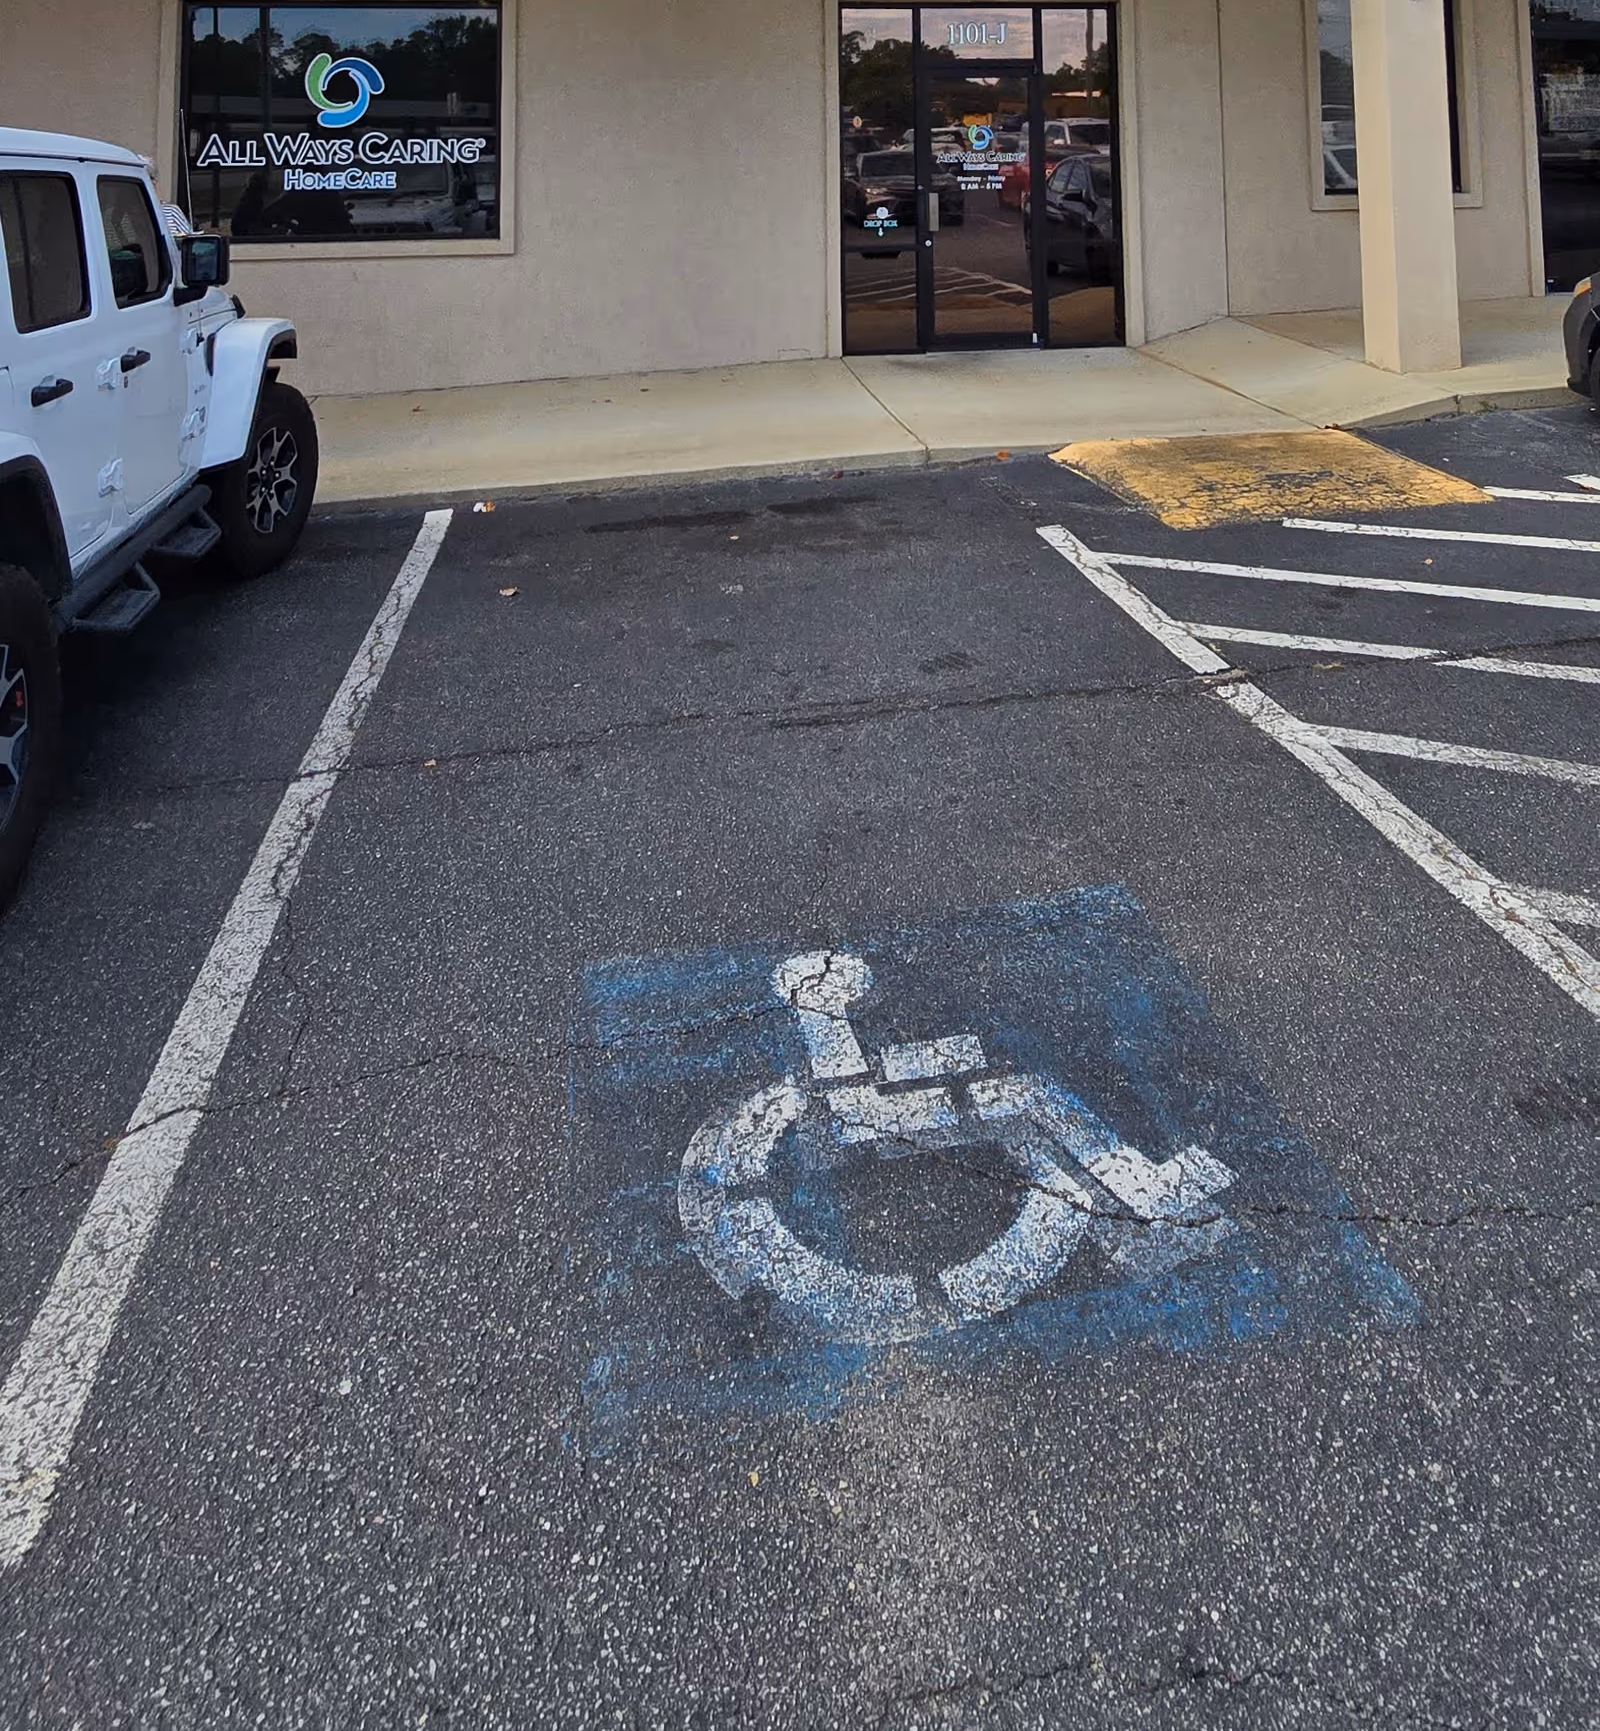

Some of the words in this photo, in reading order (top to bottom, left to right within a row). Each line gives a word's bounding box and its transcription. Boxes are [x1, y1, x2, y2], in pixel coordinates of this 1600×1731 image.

[948, 22, 1007, 45] 1101-J
[197, 134, 265, 166] ALL
[263, 133, 354, 165] WAYS
[992, 182, 1002, 190] PM
